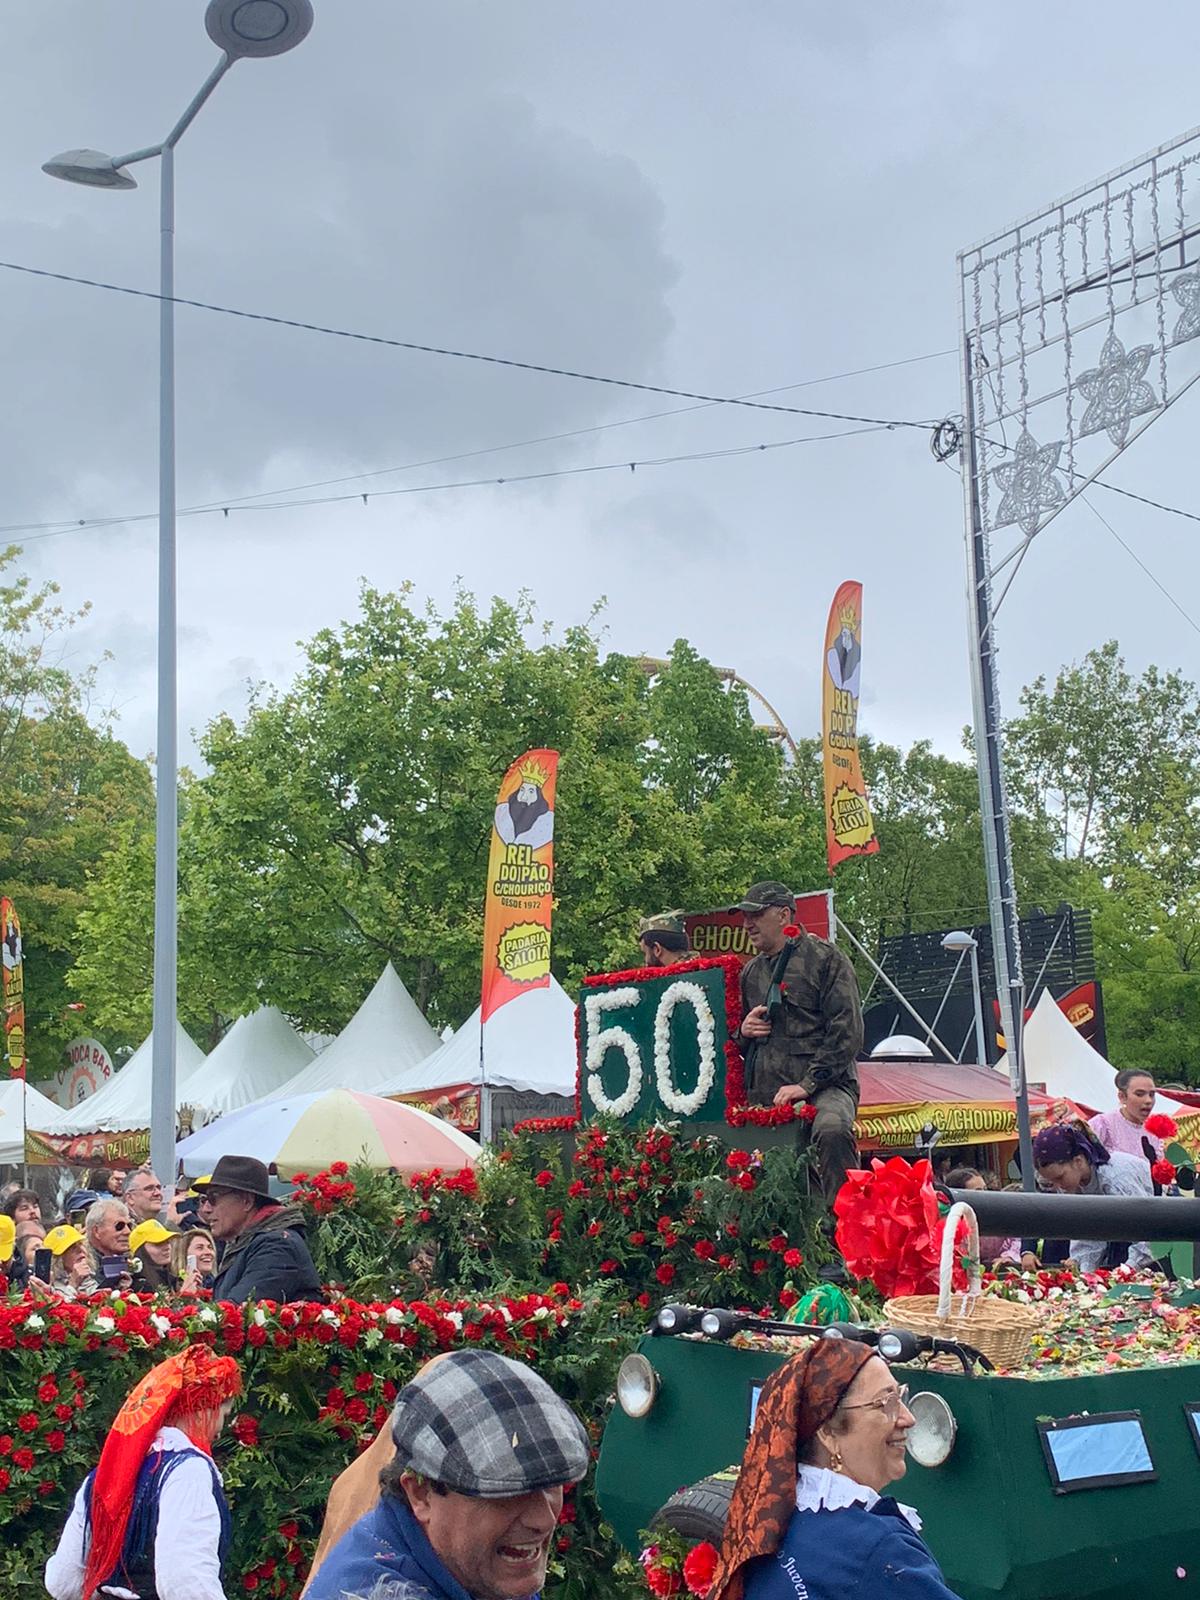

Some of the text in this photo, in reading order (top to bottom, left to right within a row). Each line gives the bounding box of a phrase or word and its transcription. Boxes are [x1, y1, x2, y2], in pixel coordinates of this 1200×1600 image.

[506, 844, 532, 866] REI
[500, 863, 549, 882] DO PÃO
[494, 881, 552, 897] C/CHOURIÇO
[501, 897, 541, 909] DESDE 1972
[505, 932, 547, 953] PADARIA
[504, 945, 550, 971] SALOIA
[584, 981, 716, 1117] 50
[92, 1047, 111, 1080] BAR
